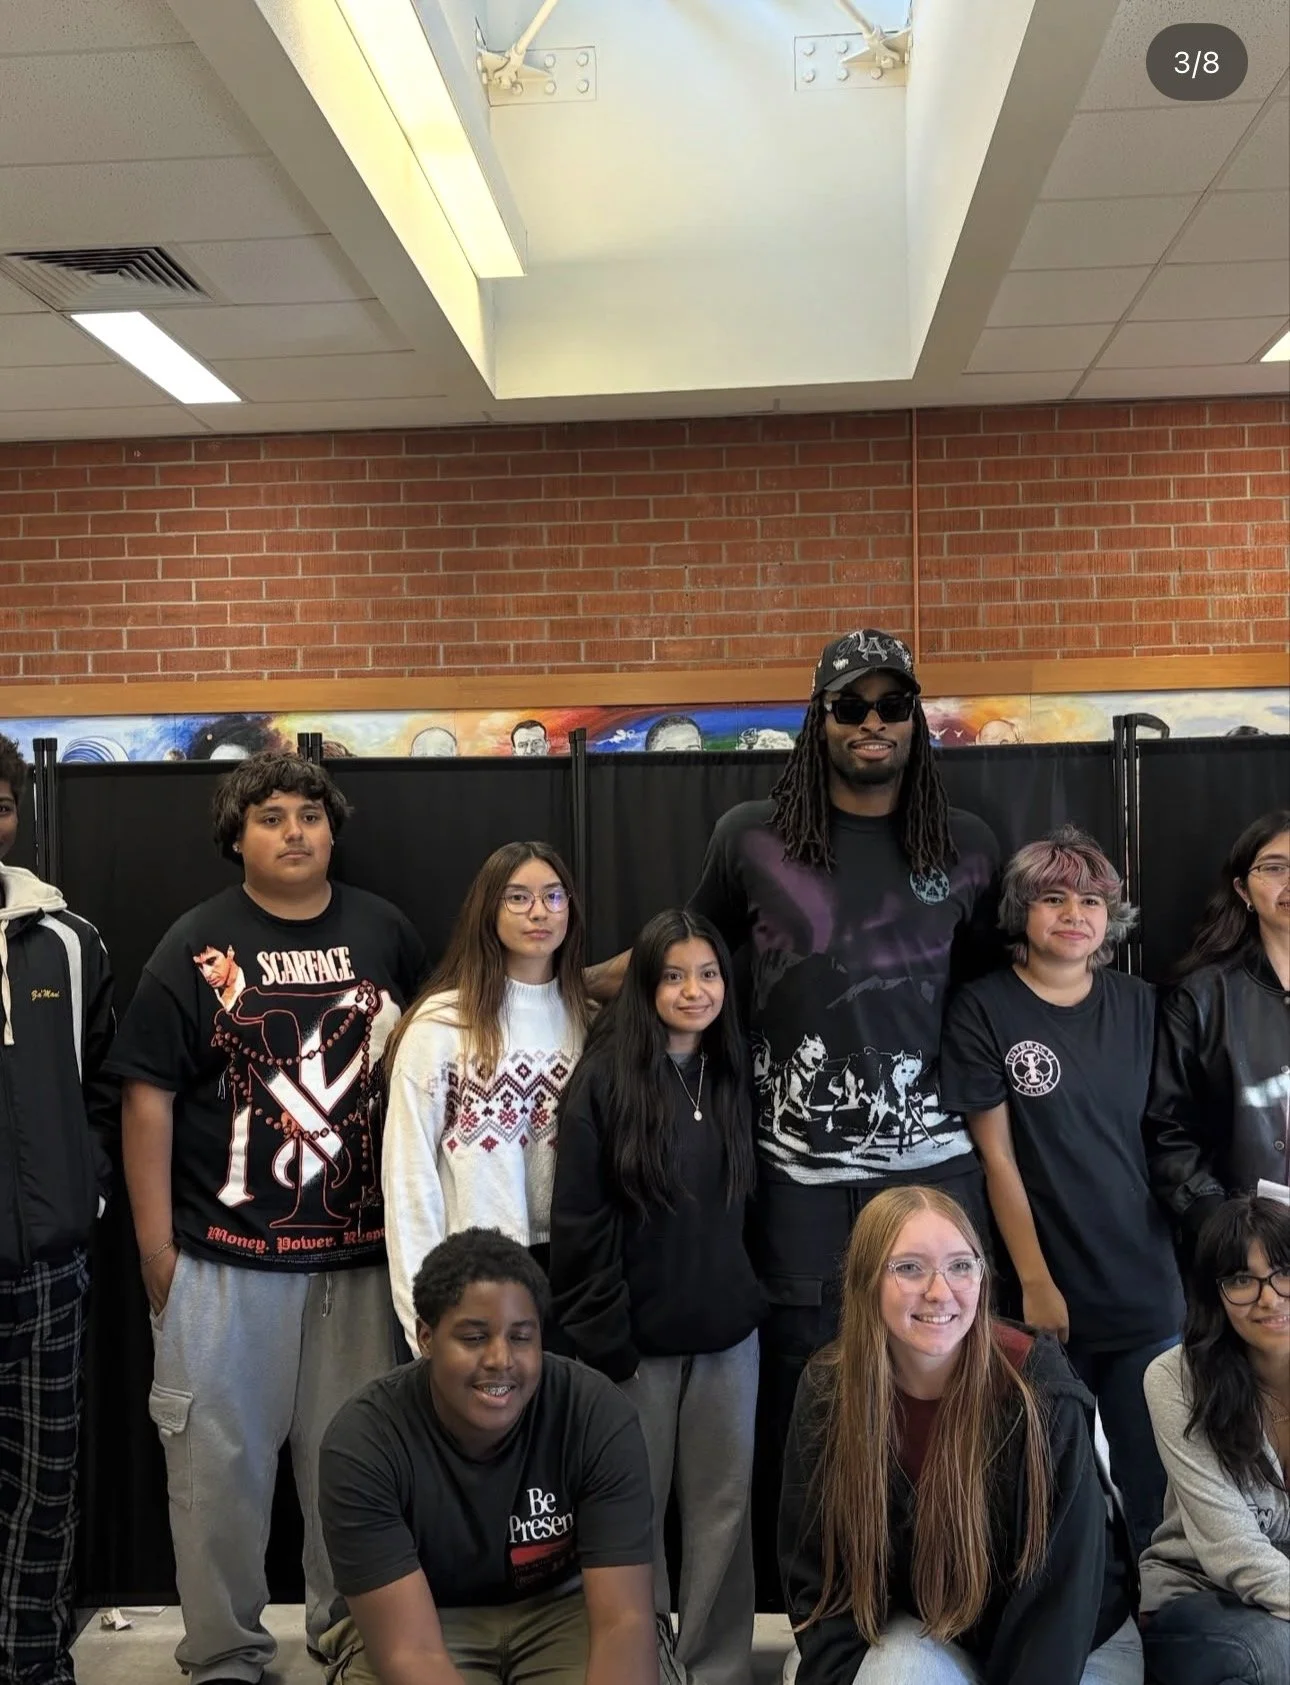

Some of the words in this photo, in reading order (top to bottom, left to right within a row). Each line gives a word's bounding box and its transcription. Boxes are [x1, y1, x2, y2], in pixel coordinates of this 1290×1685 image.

[256, 946, 356, 986] SCARFACE
[1006, 1042, 1054, 1063] INTERACT
[1023, 1083, 1050, 1095] CLUB
[526, 1487, 557, 1517] Be
[508, 1508, 575, 1544] Presen
